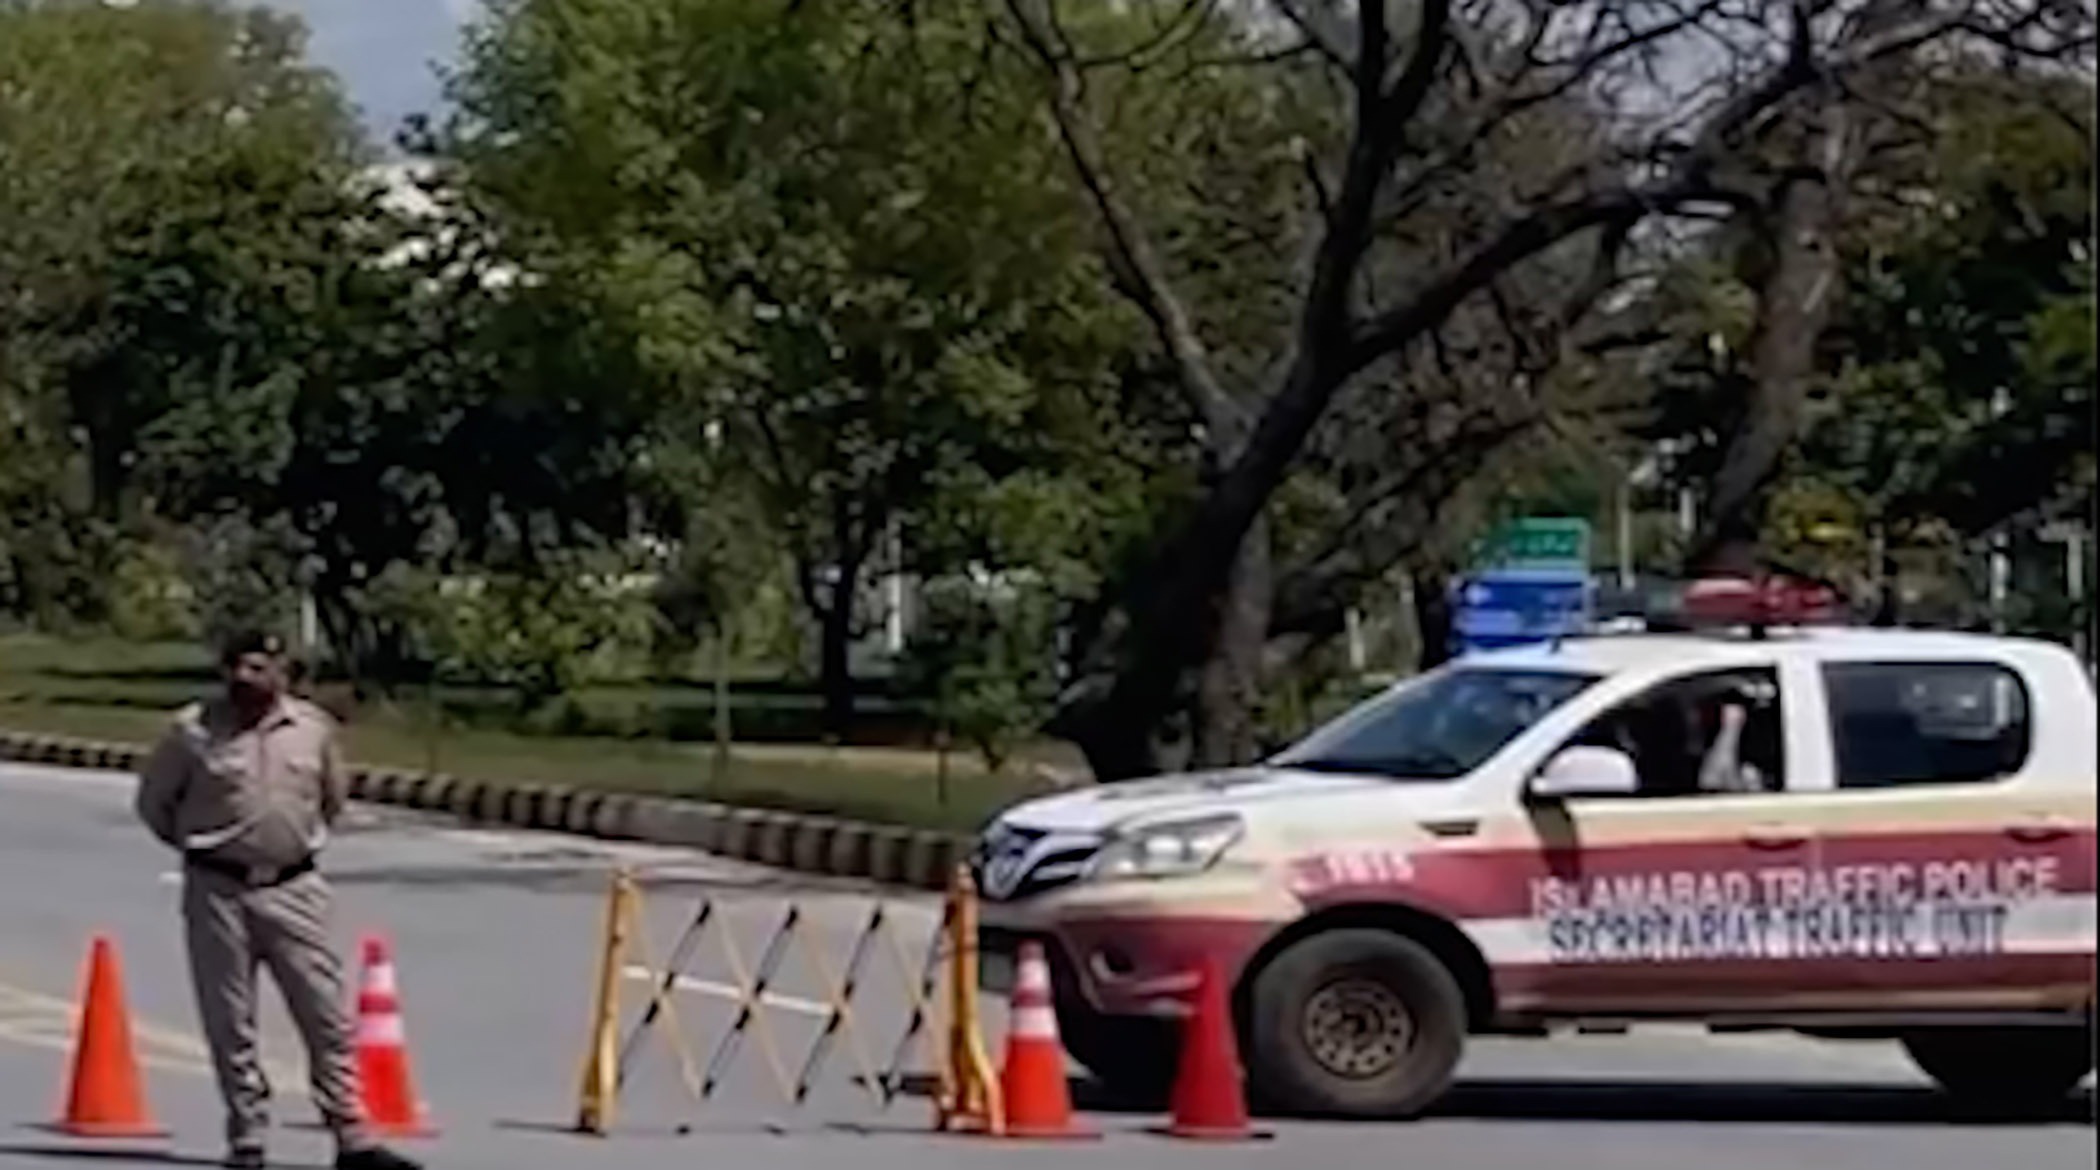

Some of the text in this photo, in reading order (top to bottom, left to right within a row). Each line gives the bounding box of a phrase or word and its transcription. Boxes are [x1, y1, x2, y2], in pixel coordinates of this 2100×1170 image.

[1529, 857, 2060, 916] ISLAMABAD TRAFFIC POLICE
[1549, 901, 2007, 956] SECRETARIAT TRAFFIC UNIT
